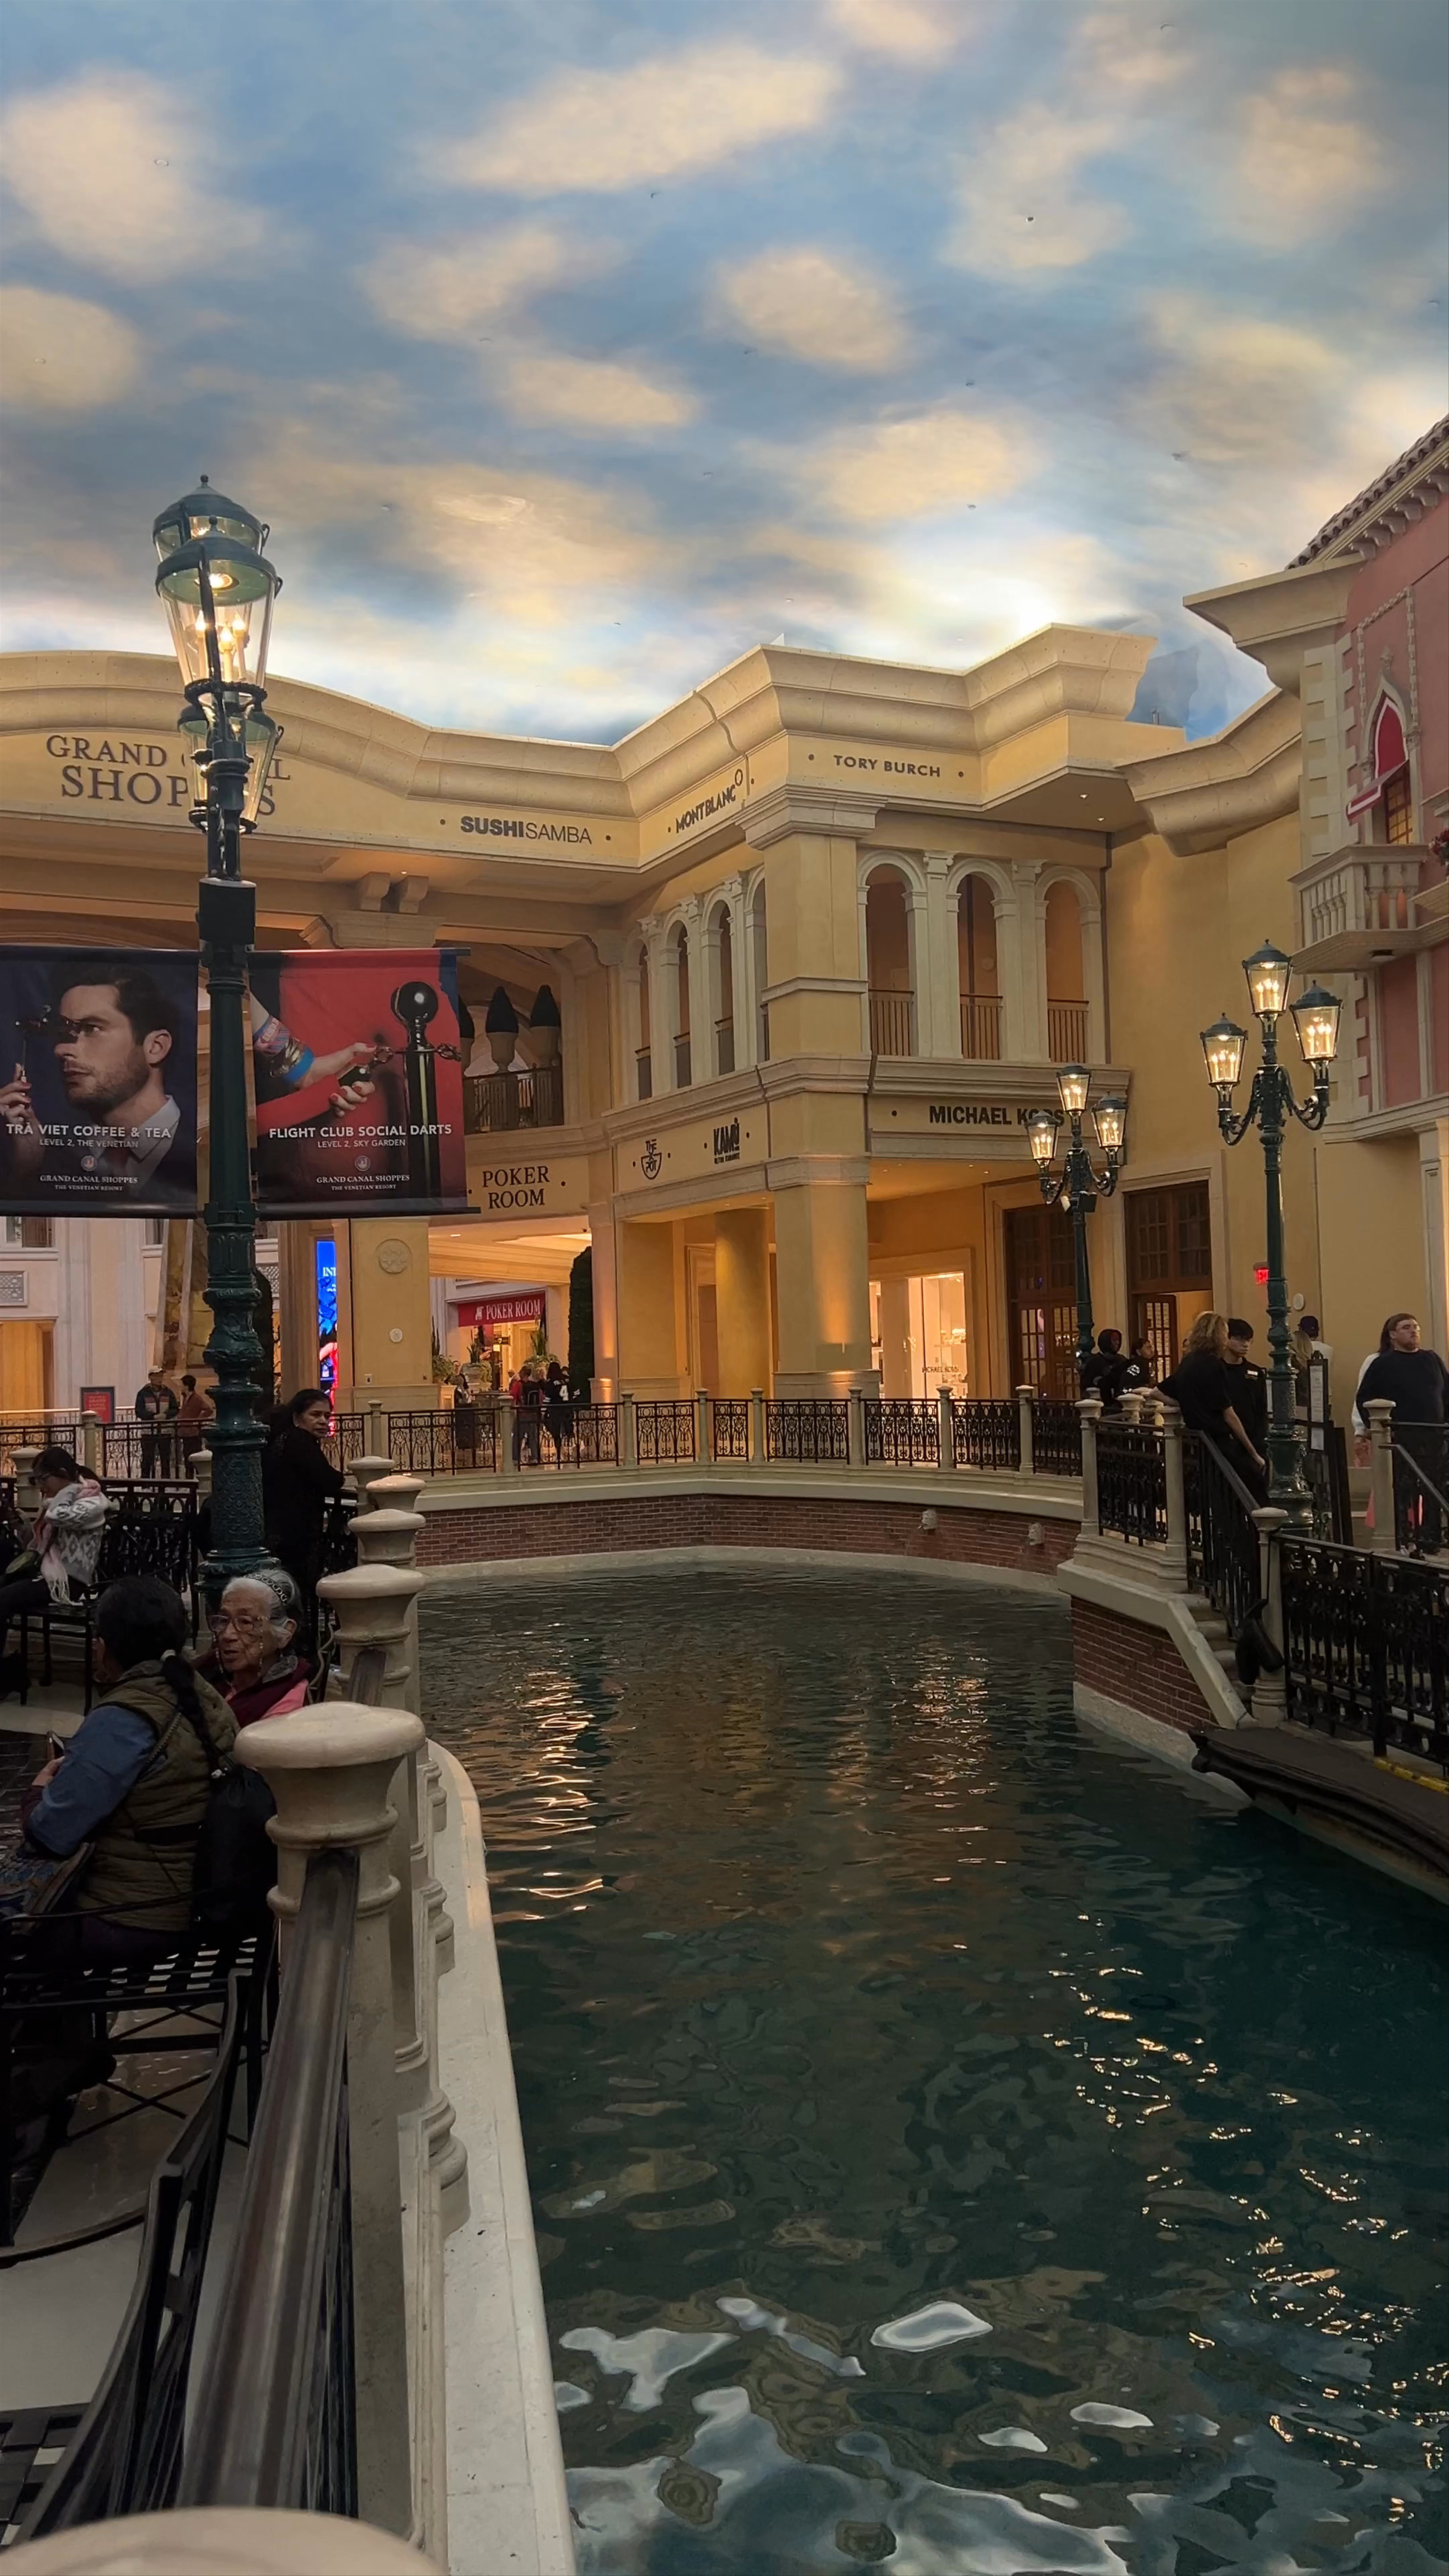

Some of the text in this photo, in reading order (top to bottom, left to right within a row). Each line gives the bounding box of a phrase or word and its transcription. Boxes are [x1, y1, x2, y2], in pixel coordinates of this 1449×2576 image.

[46, 735, 166, 767] GRAND
[834, 755, 940, 777] TORY BURCH
[62, 764, 275, 815] SHOPS
[676, 784, 736, 834] MONTBLANC
[460, 815, 592, 844] SUSHISAMBA
[929, 1105, 1012, 1125] MICHAEL
[38, 1124, 69, 1135] VIET
[73, 1126, 125, 1137] COFFEE
[131, 1127, 140, 1137] &
[145, 1127, 171, 1138] TEA
[269, 1124, 452, 1138] FLIGHT CLUB SOCIAL DARTS
[483, 1166, 550, 1187] POKER
[488, 1189, 545, 1209] ROOM
[486, 1299, 540, 1320] POKER ROOM
